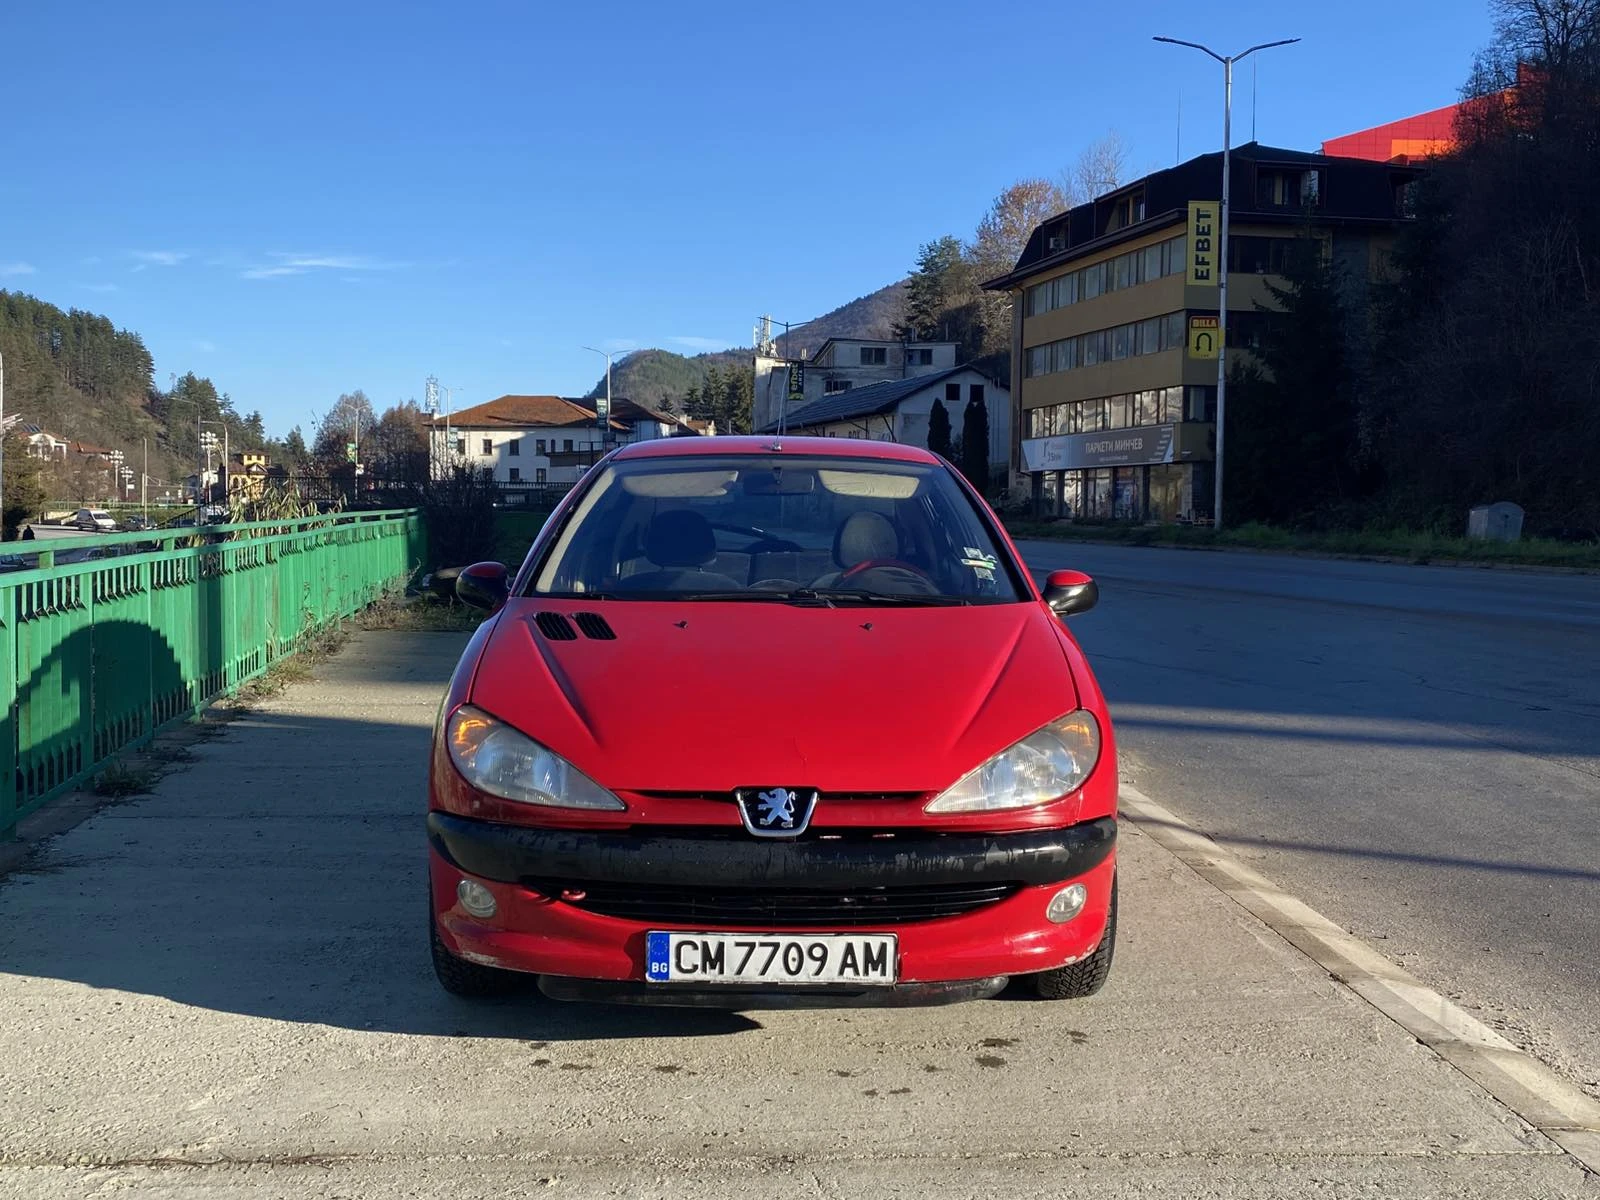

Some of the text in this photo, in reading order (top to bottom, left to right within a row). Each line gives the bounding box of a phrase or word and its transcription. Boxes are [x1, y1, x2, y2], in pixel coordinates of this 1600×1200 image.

[1194, 208, 1212, 281] EFBET
[1085, 438, 1143, 454] ПАРКЕТИ МИНЧЕВ
[651, 962, 668, 974] BG
[674, 940, 888, 977] CM 7709 AM
